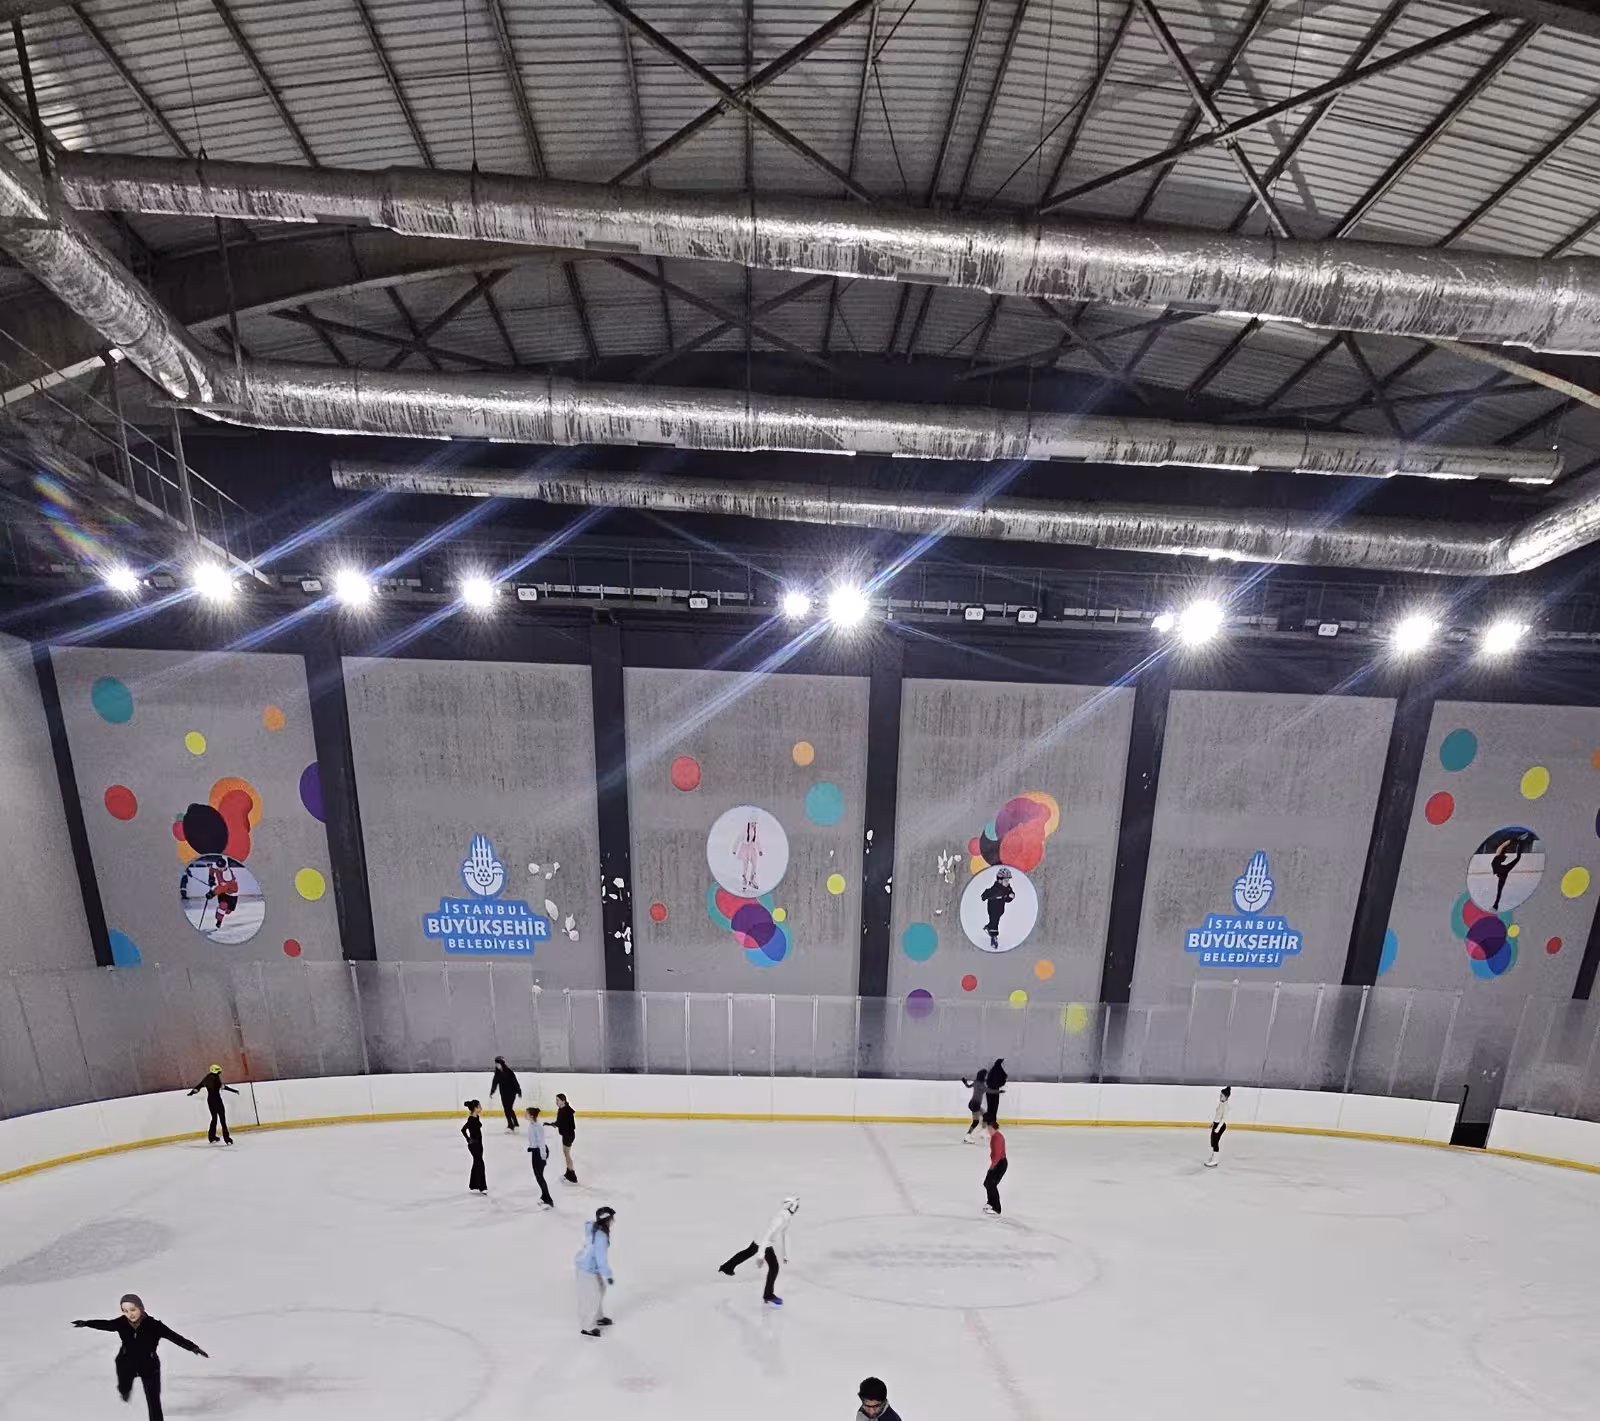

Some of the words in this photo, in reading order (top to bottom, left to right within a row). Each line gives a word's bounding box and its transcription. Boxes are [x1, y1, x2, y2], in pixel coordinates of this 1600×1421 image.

[444, 902, 527, 916] İSTANBUL
[427, 916, 547, 937] BÜYÜKŞEHİR
[1208, 918, 1284, 930] İSTANBUL
[448, 938, 530, 950] BELEDİYESİ
[1188, 931, 1299, 950] BÜYÜKŞEHİR
[1203, 952, 1279, 963] BELEDİYESİ
